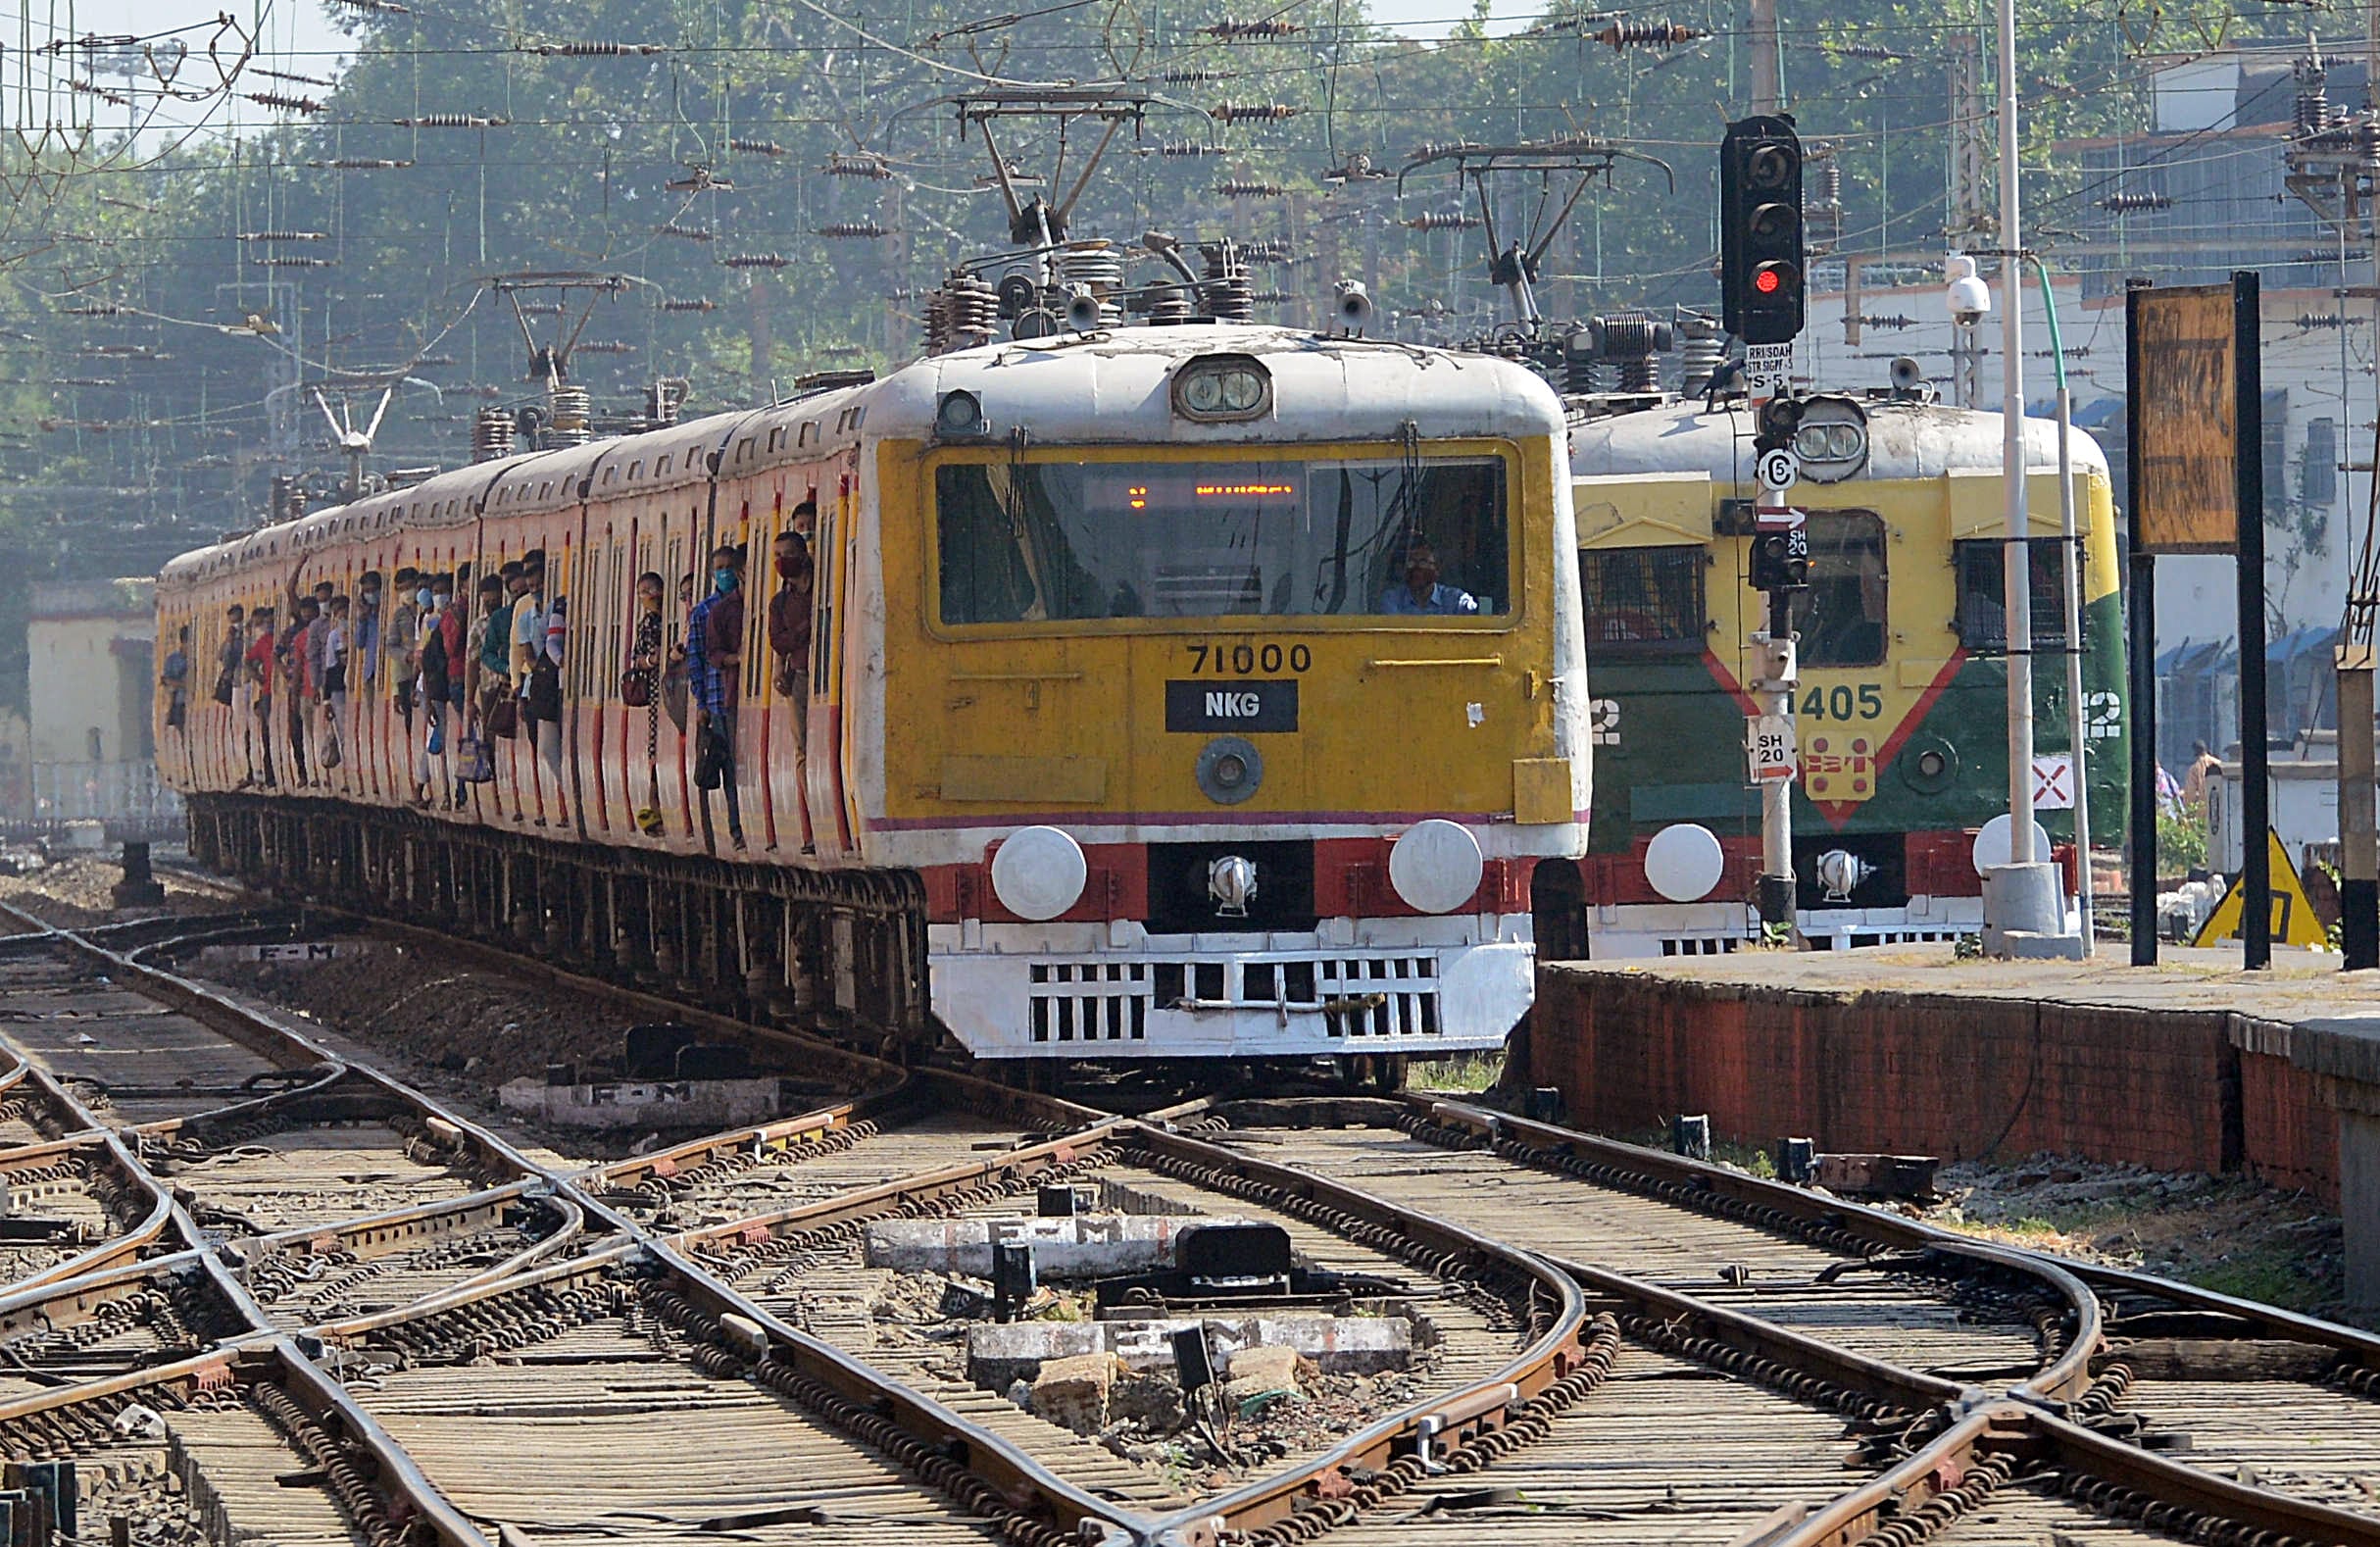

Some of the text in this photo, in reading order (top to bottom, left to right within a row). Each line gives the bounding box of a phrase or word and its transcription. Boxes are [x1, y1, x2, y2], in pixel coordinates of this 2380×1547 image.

[1767, 454, 1792, 485] C
[1776, 463, 1785, 475] 5
[1789, 529, 1807, 541] SH
[1788, 541, 1808, 556] 20
[1186, 643, 1312, 674] 71000
[1205, 691, 1261, 718] NKG
[1759, 734, 1783, 748] SH
[1760, 748, 1784, 764] 20
